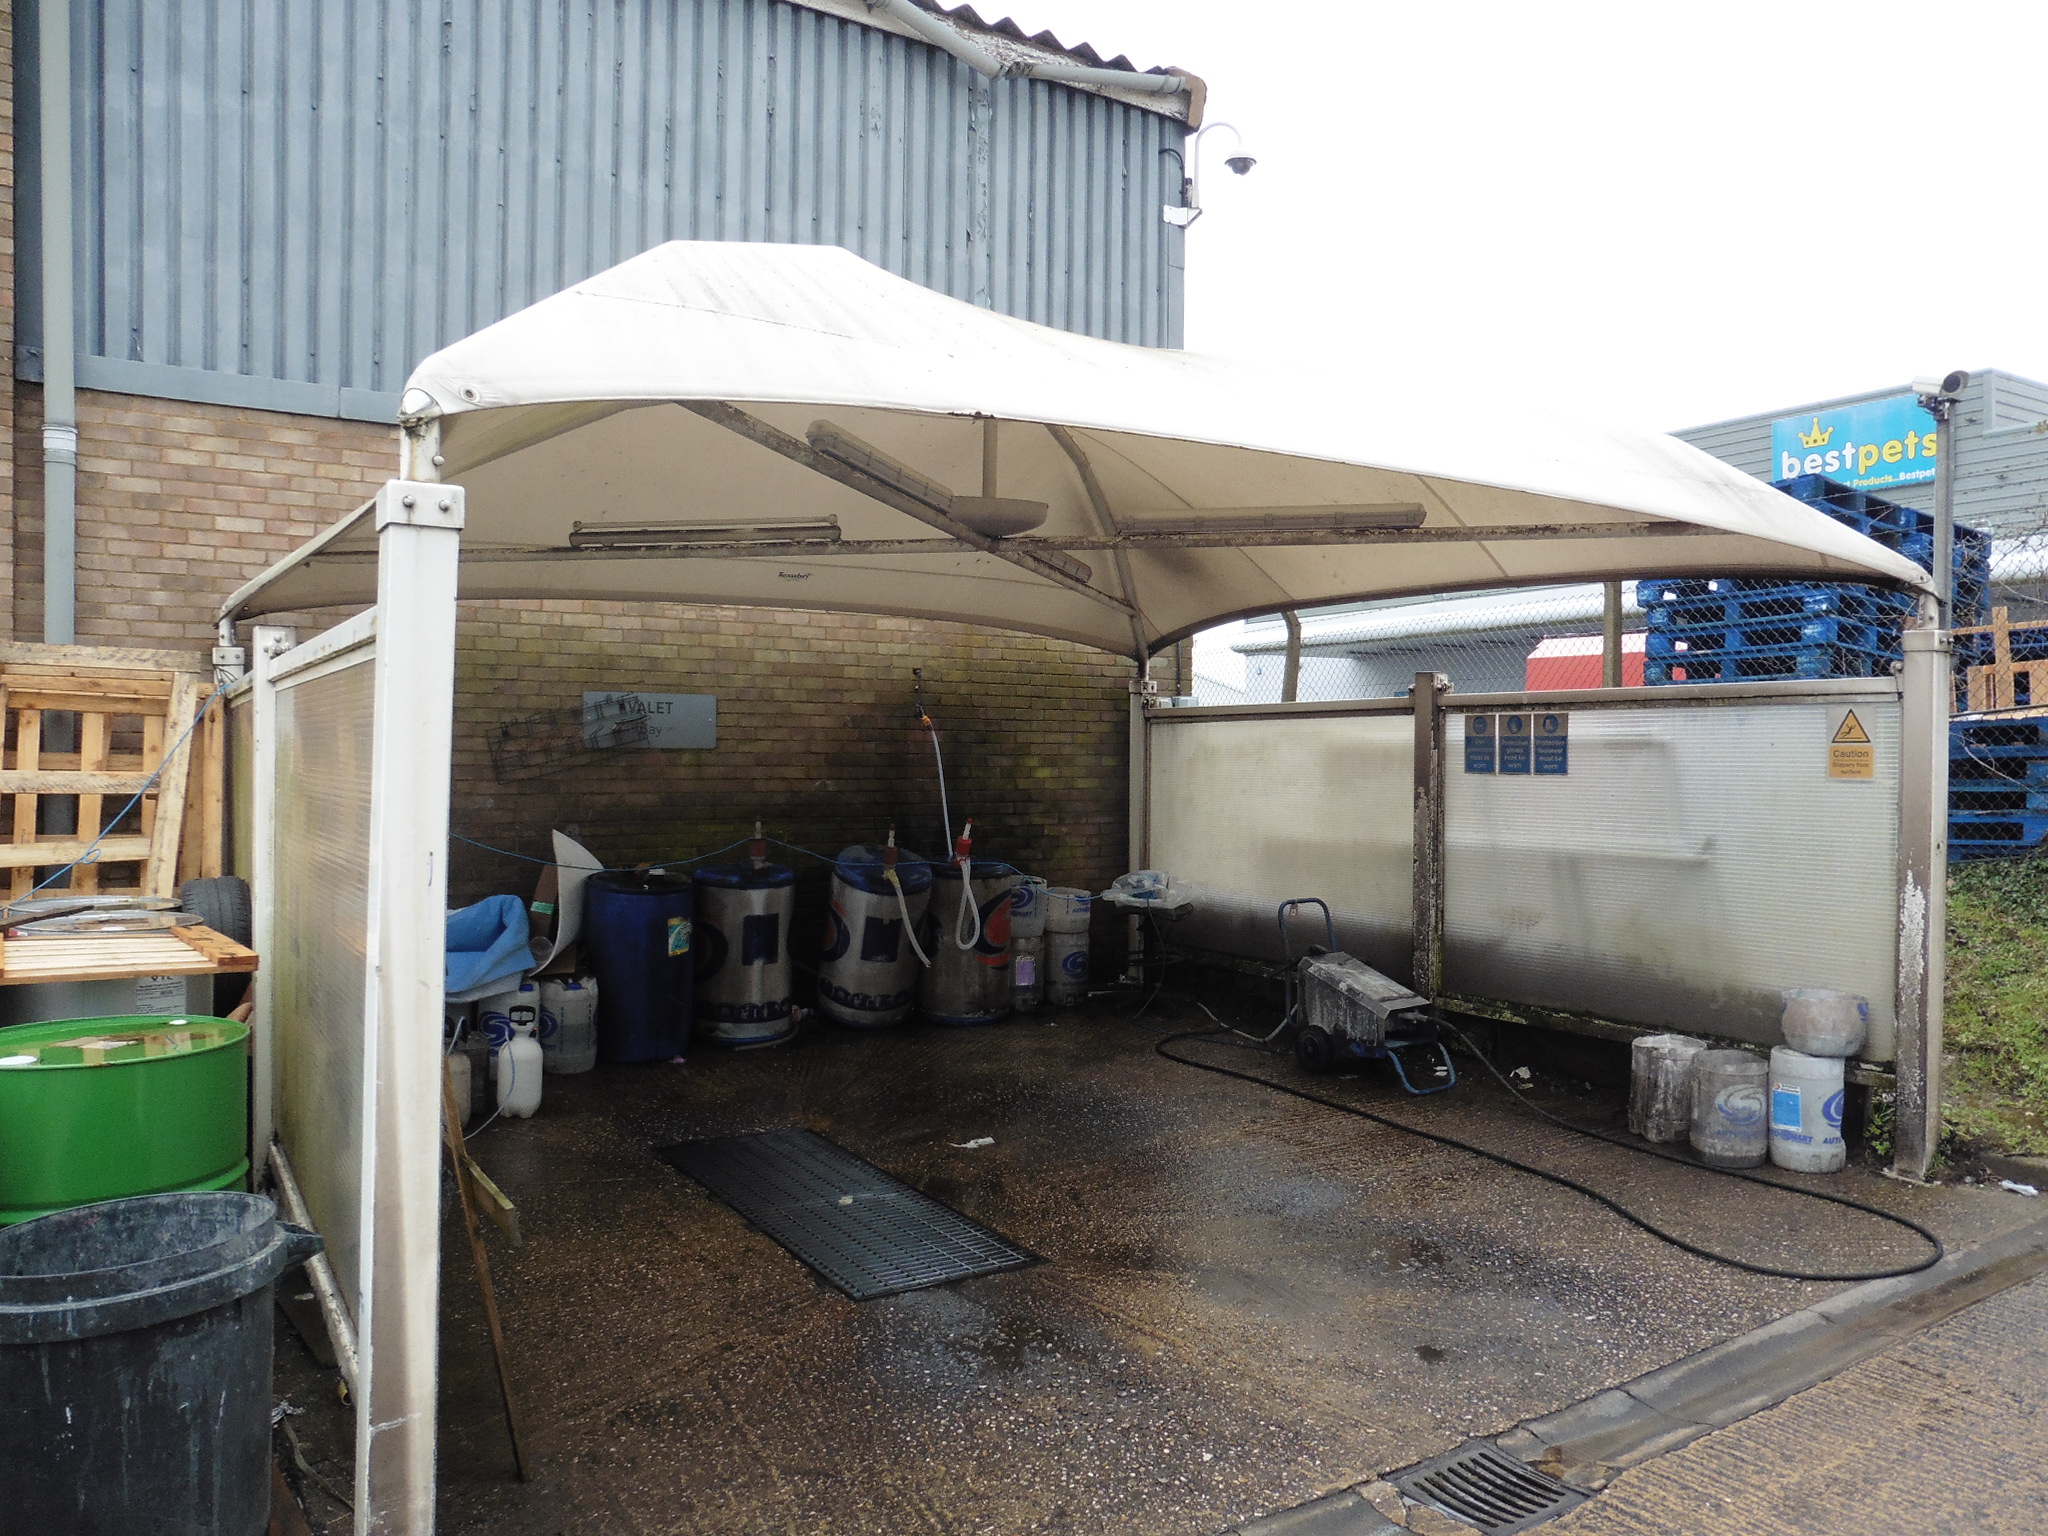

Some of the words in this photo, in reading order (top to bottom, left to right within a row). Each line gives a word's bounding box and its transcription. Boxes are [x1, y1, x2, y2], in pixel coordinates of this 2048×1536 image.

[1781, 430, 1937, 480] bestpets
[627, 701, 673, 714] VALET
[1833, 749, 1869, 758] Caution
